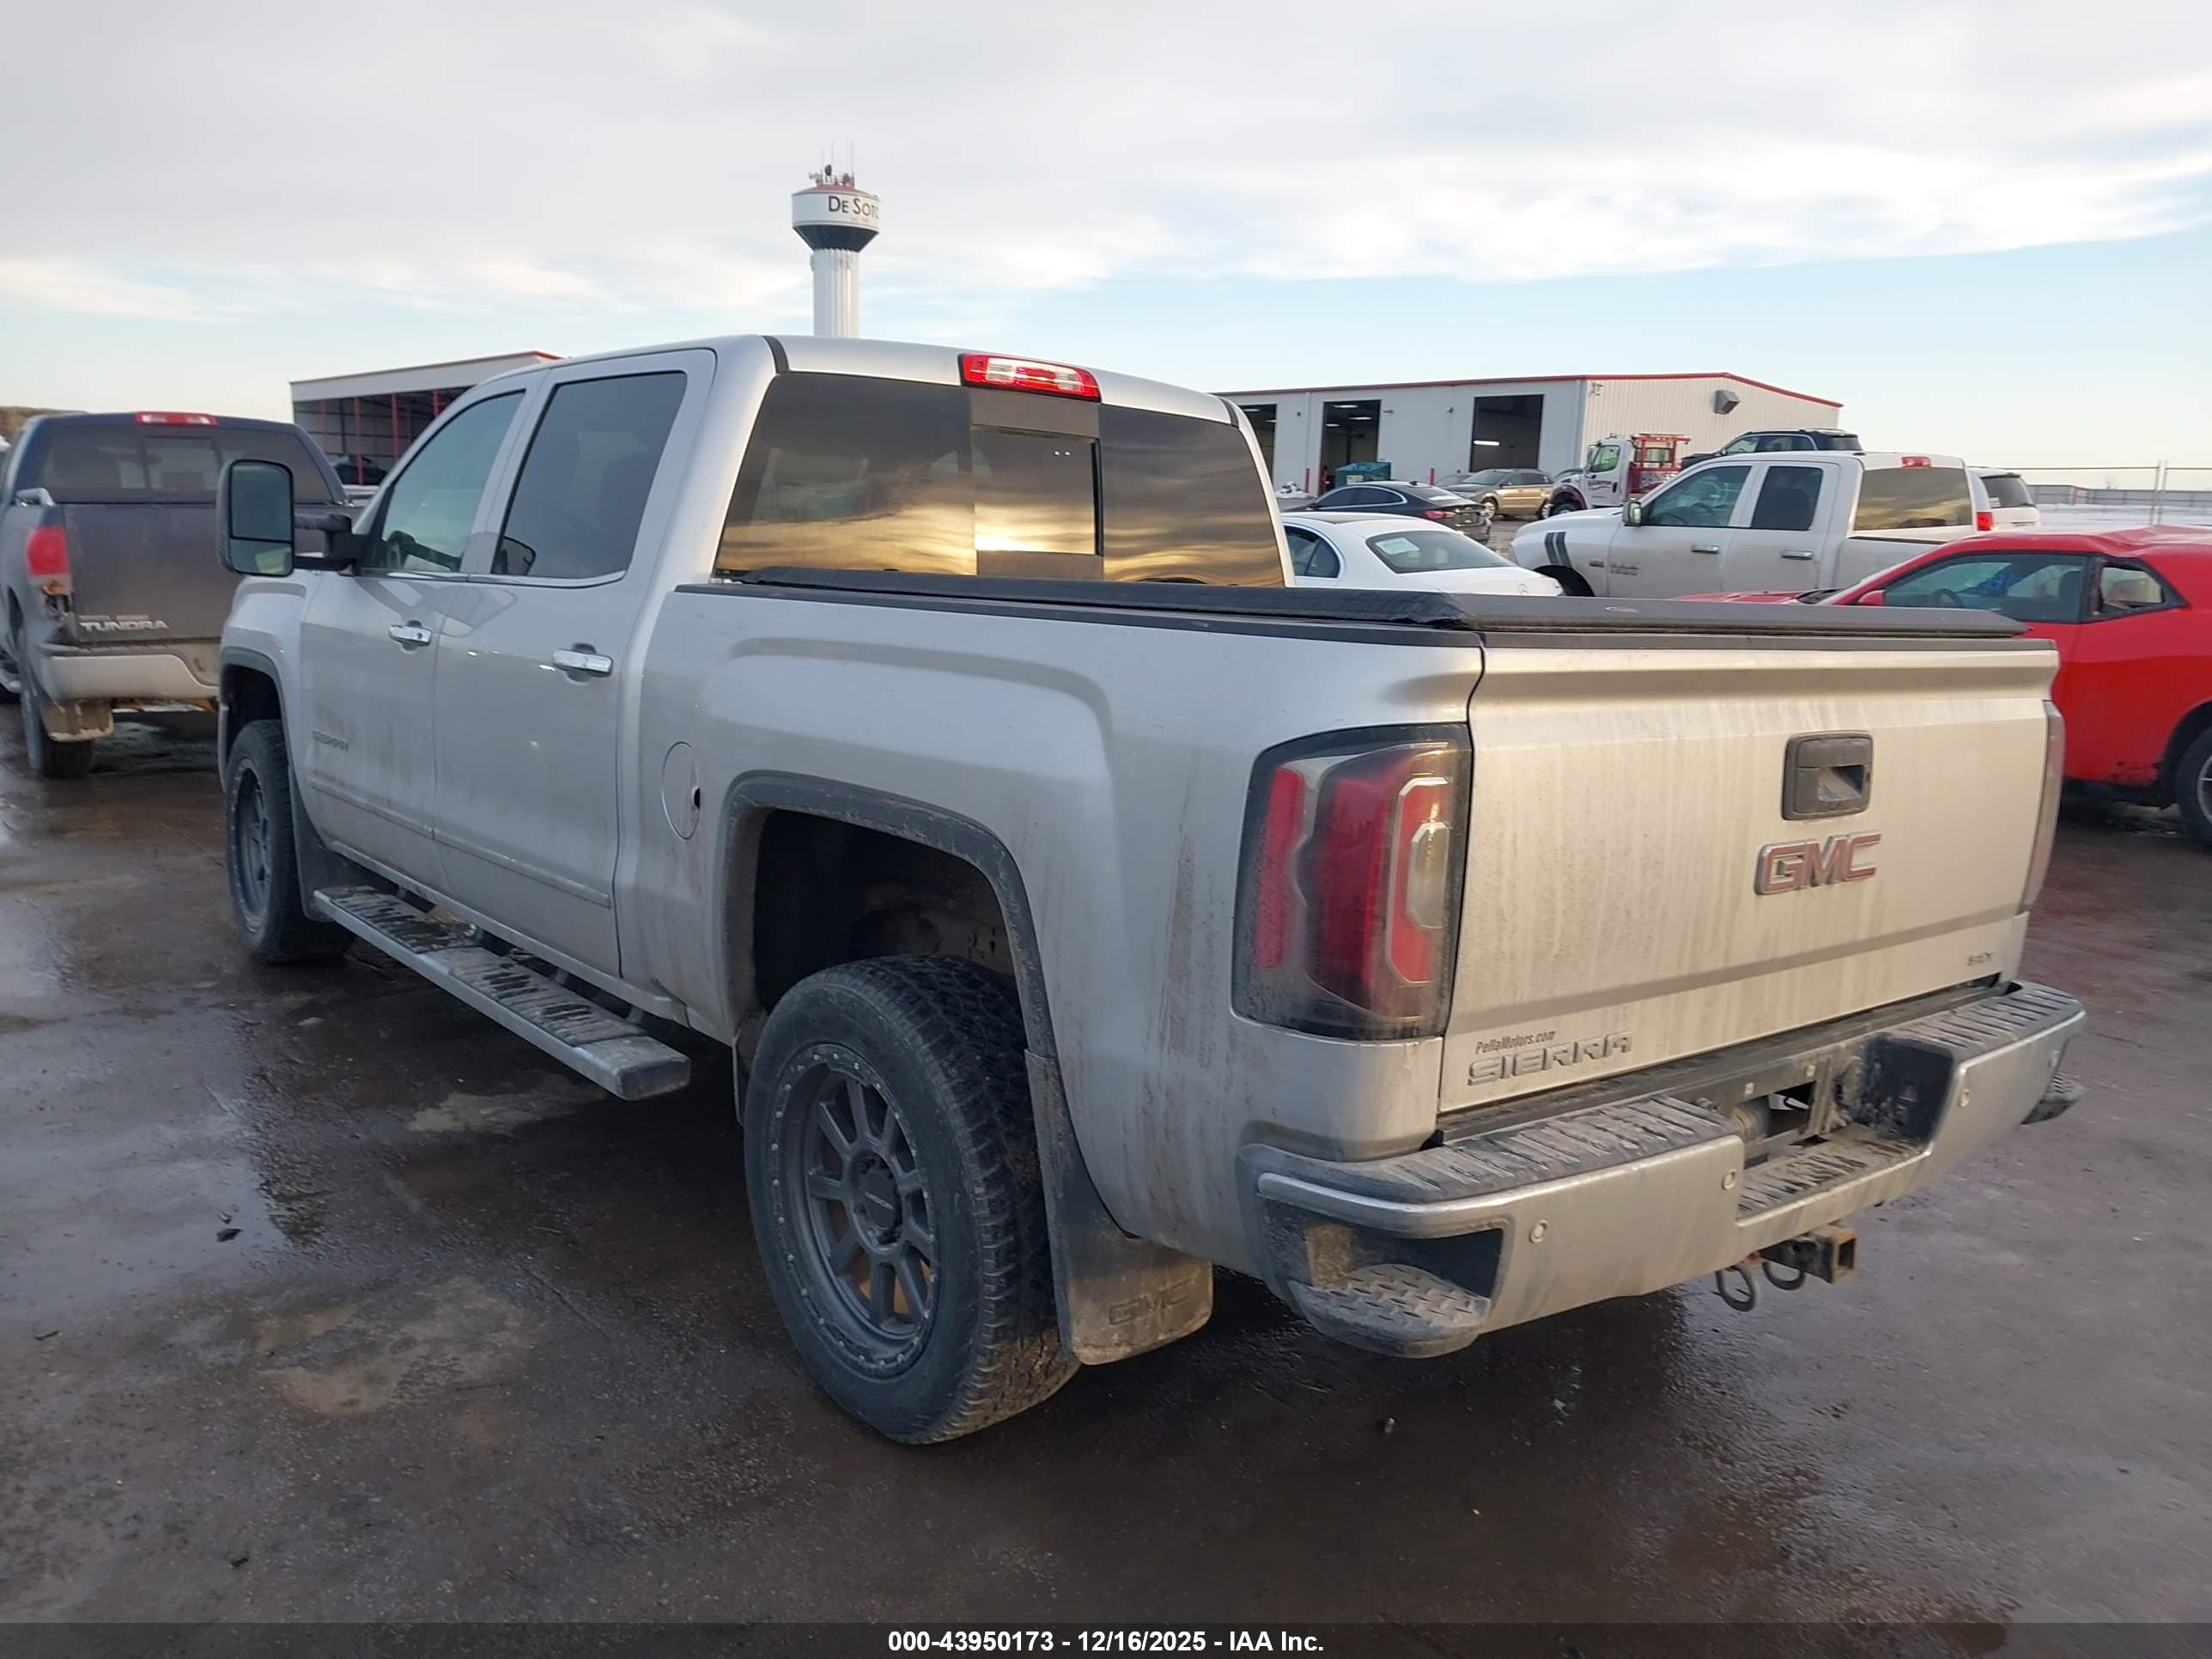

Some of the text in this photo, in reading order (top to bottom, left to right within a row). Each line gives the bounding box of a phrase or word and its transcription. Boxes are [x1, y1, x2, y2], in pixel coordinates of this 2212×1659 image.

[79, 619, 170, 633] TUNDRA
[1754, 830, 1882, 895] GMC
[1468, 1030, 1632, 1086] SIERRA
[1108, 1276, 1196, 1326] GMC
